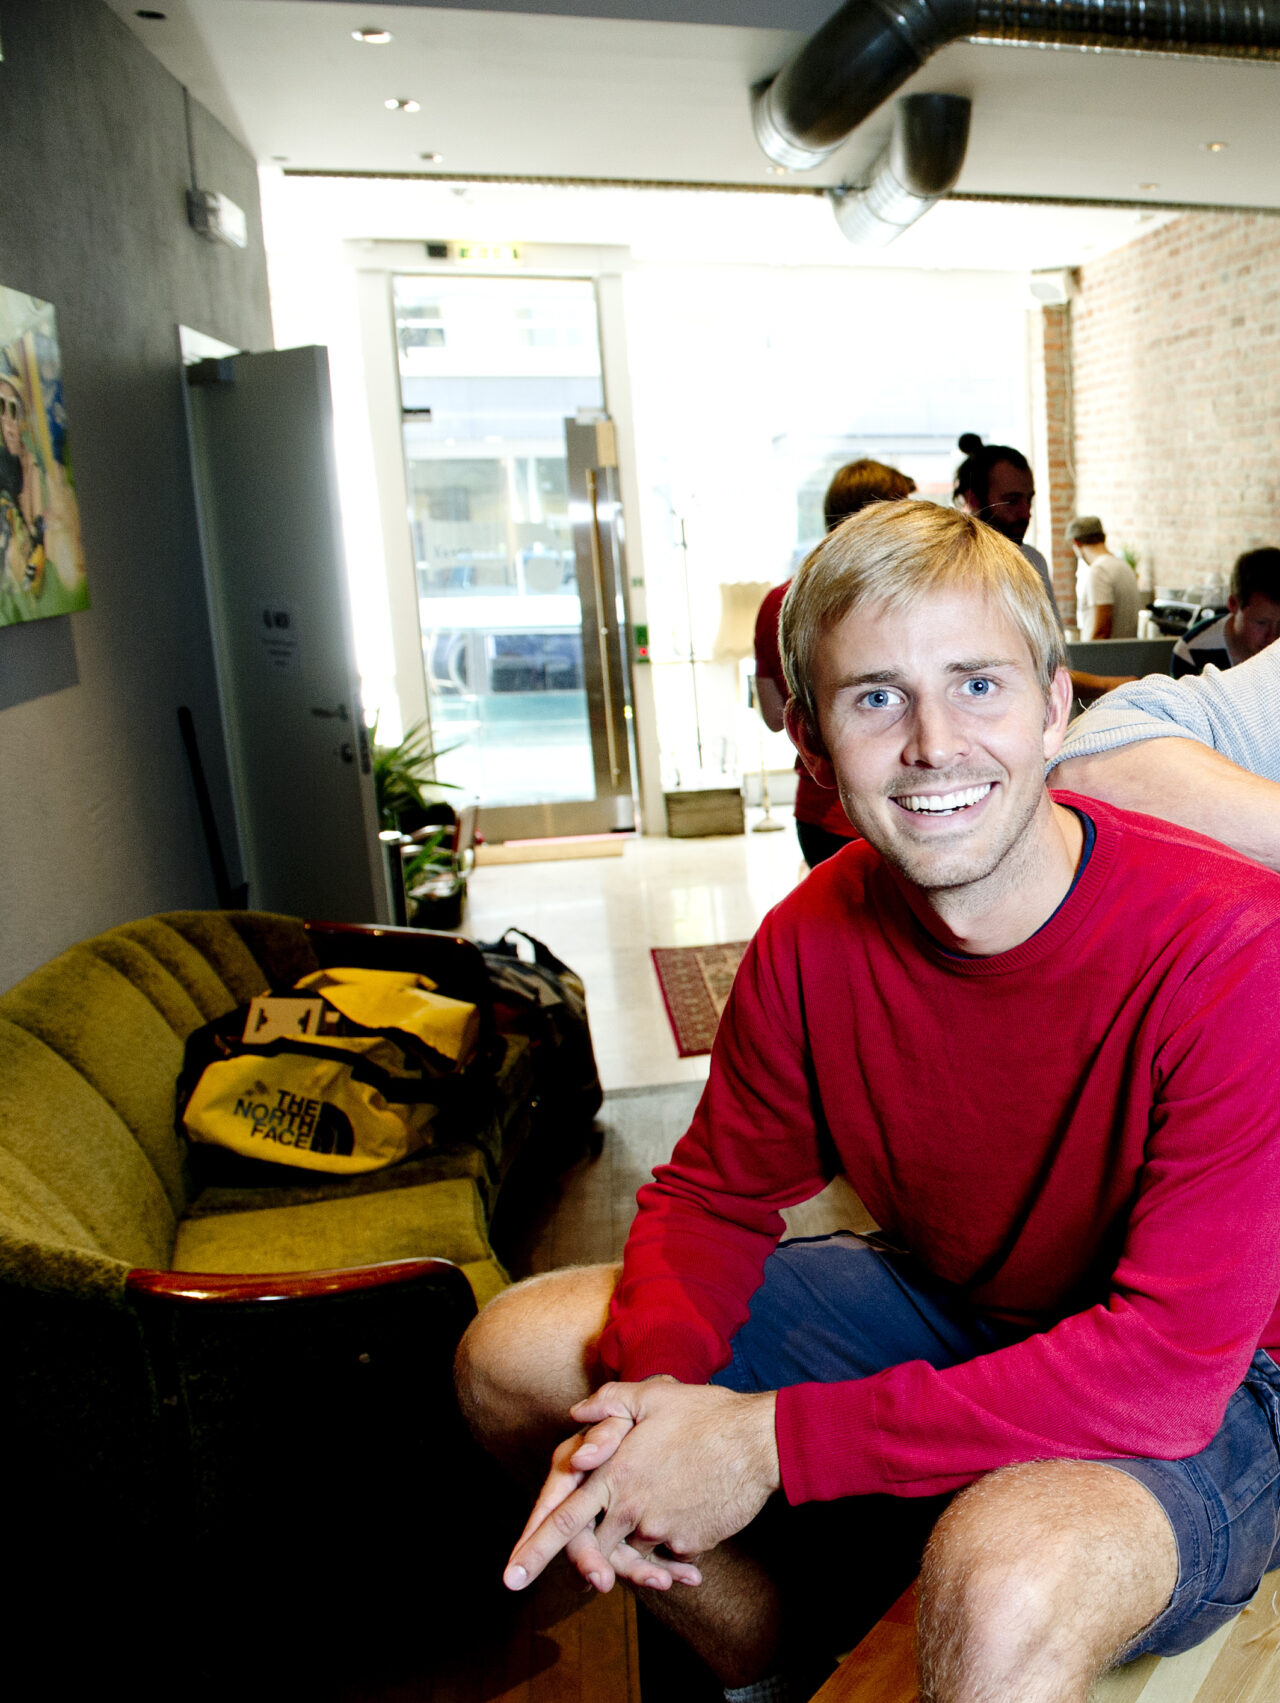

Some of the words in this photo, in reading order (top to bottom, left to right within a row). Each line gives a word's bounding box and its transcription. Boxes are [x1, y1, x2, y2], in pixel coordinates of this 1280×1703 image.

[233, 1098, 316, 1138] NORTH
[277, 1088, 320, 1119] THE
[250, 1121, 308, 1150] FACE
